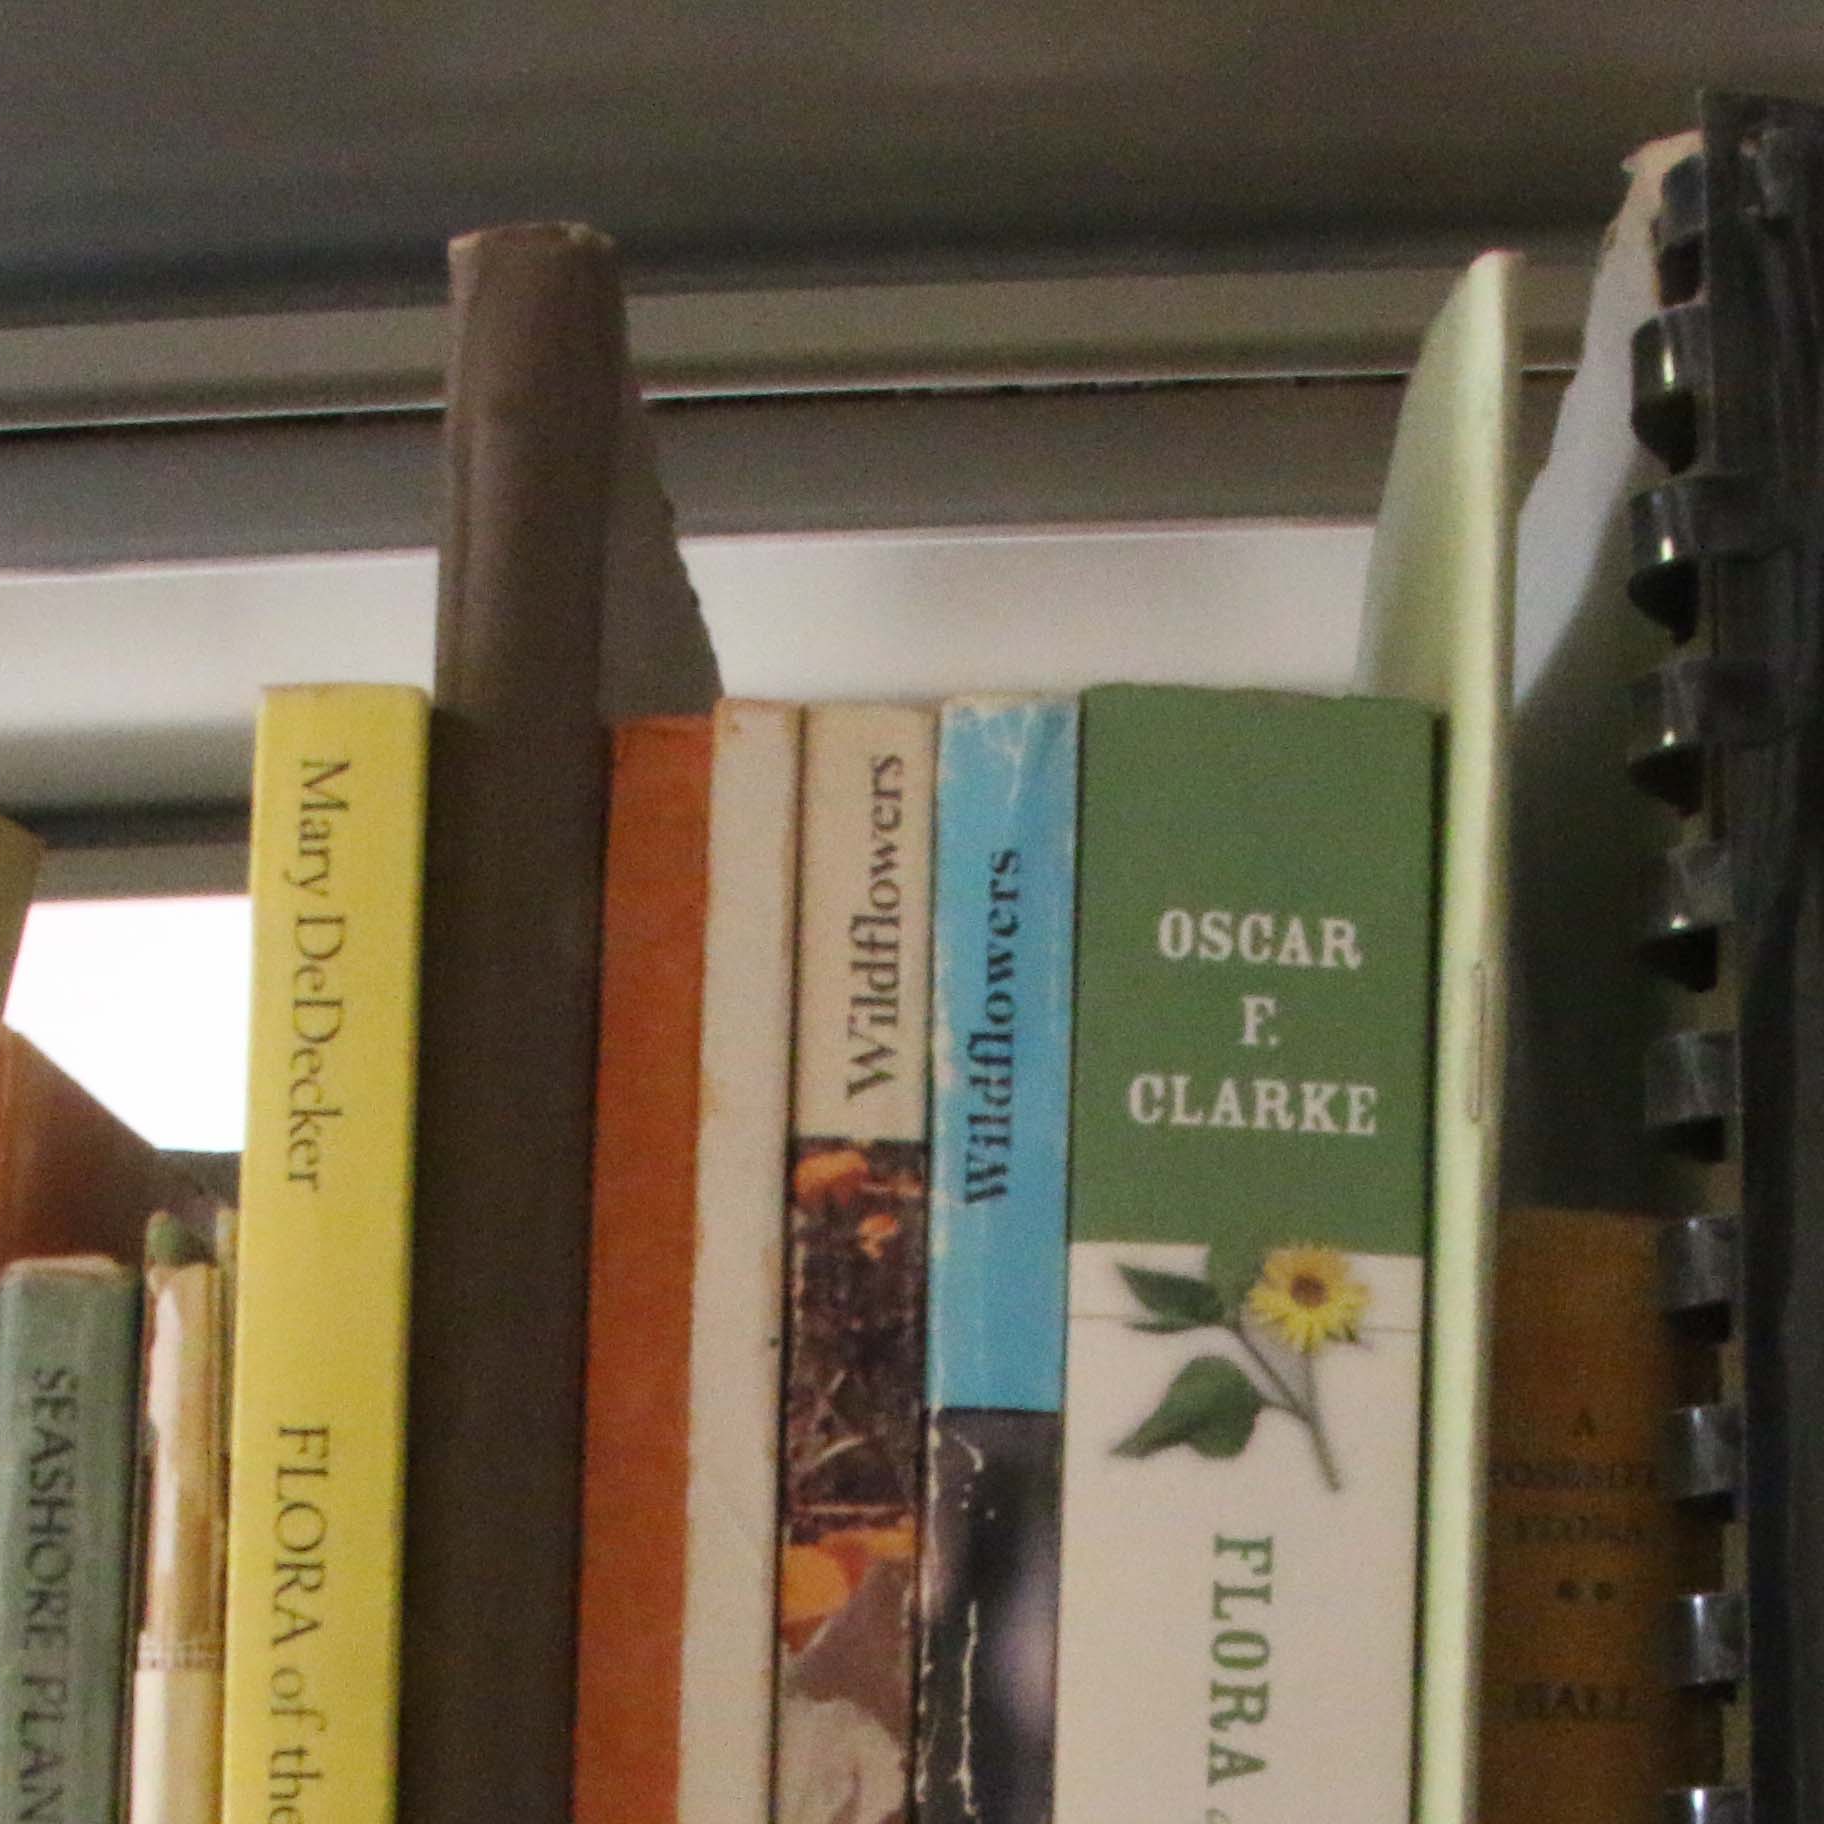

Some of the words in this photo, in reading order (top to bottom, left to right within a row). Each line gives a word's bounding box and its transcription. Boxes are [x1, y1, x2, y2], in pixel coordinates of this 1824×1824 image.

[285, 757, 351, 898] Mary
[846, 751, 906, 1099] Wildflowers
[964, 847, 1021, 1207] Wildflowers
[1157, 909, 1364, 971] OSCAR
[1241, 995, 1278, 1048] F.
[287, 912, 347, 1192] DeDecker
[1127, 1073, 1378, 1137] CLARKE
[21, 1366, 76, 1651] SEASHORE
[271, 1425, 330, 1646] FLORA
[271, 1667, 328, 1731] of
[1206, 1532, 1274, 1788] FLORA
